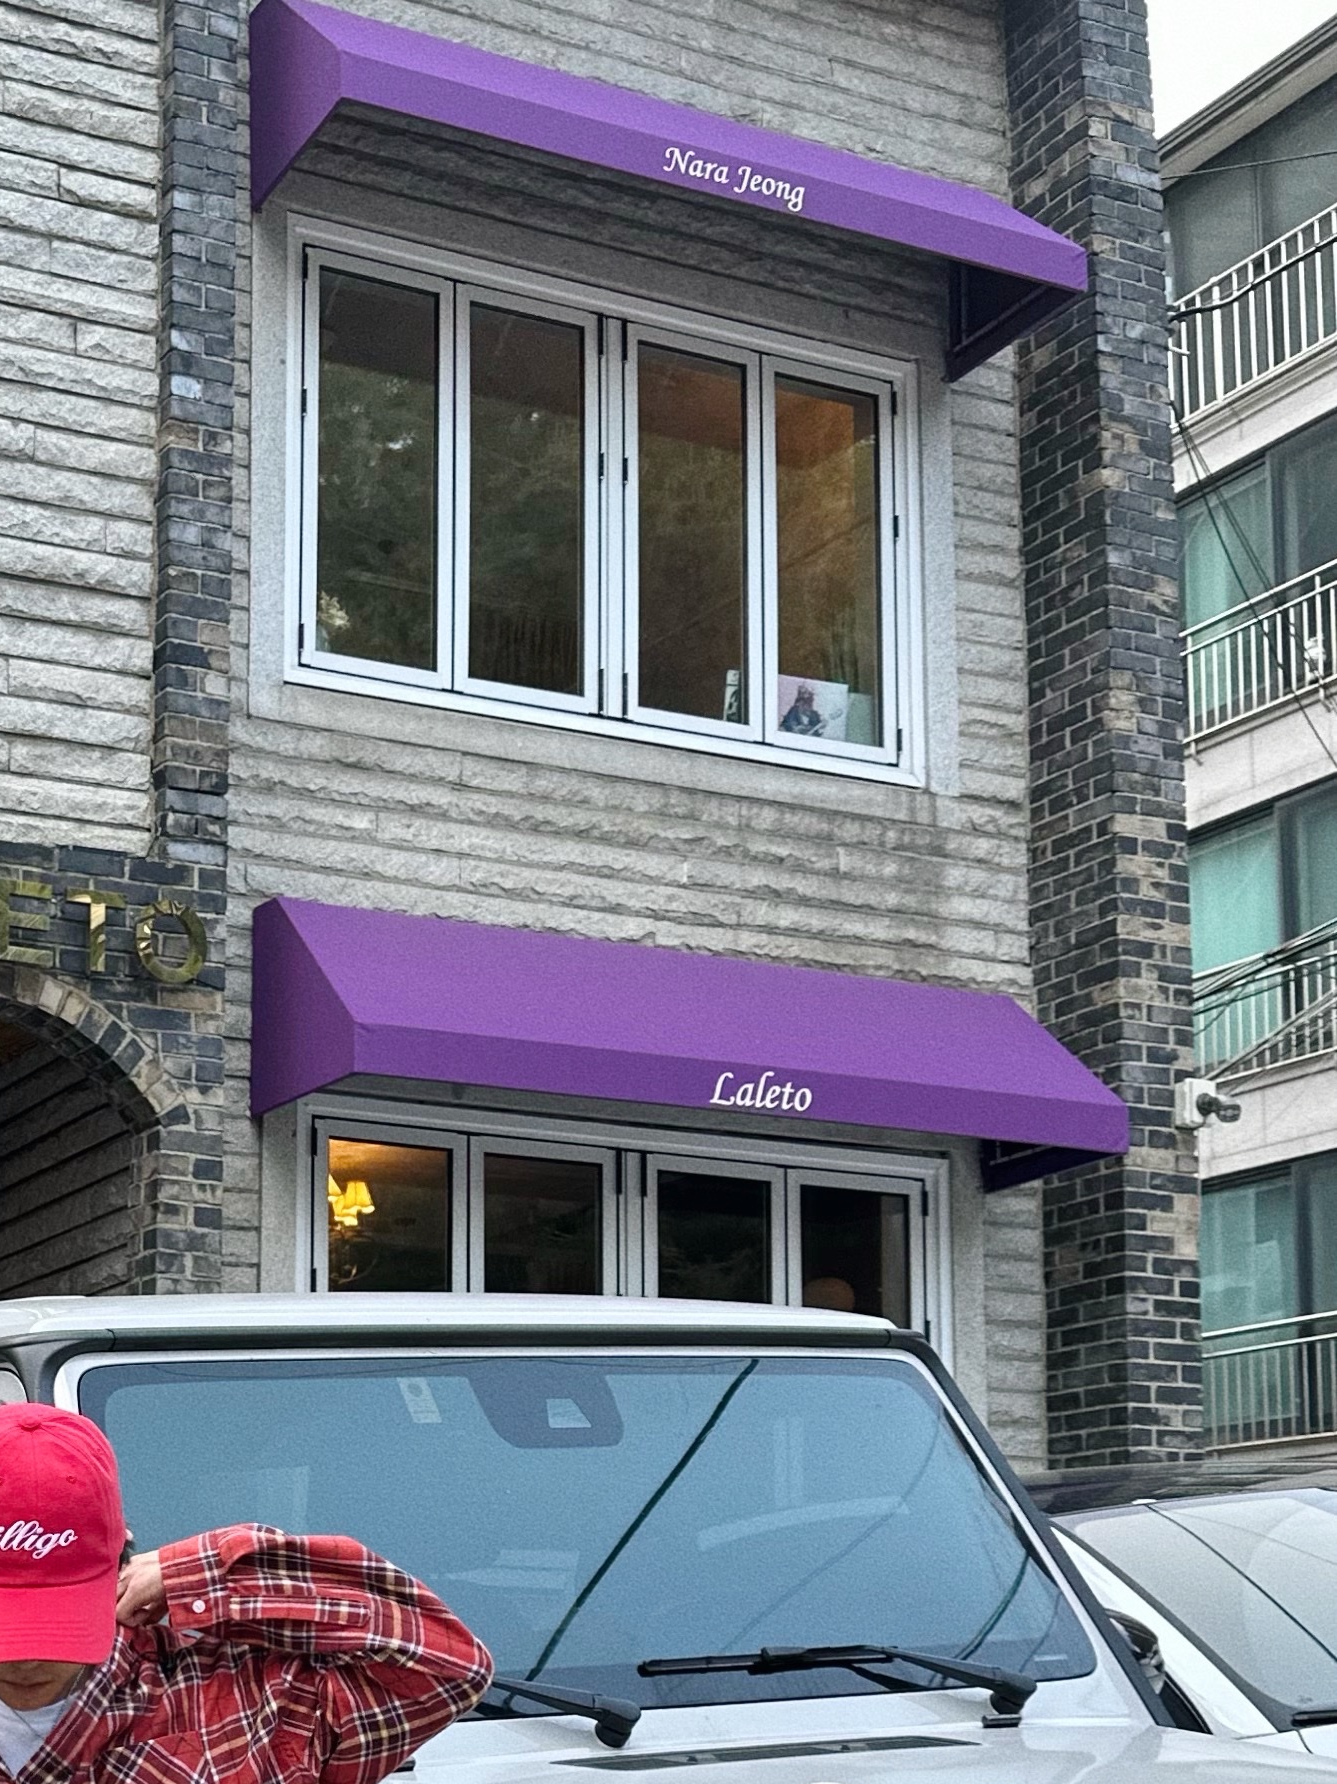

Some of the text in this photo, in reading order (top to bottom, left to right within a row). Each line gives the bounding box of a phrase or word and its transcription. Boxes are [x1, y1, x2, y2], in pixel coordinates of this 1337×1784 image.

[662, 146, 805, 212] Nara Jeong
[709, 1070, 812, 1112] Laleto
